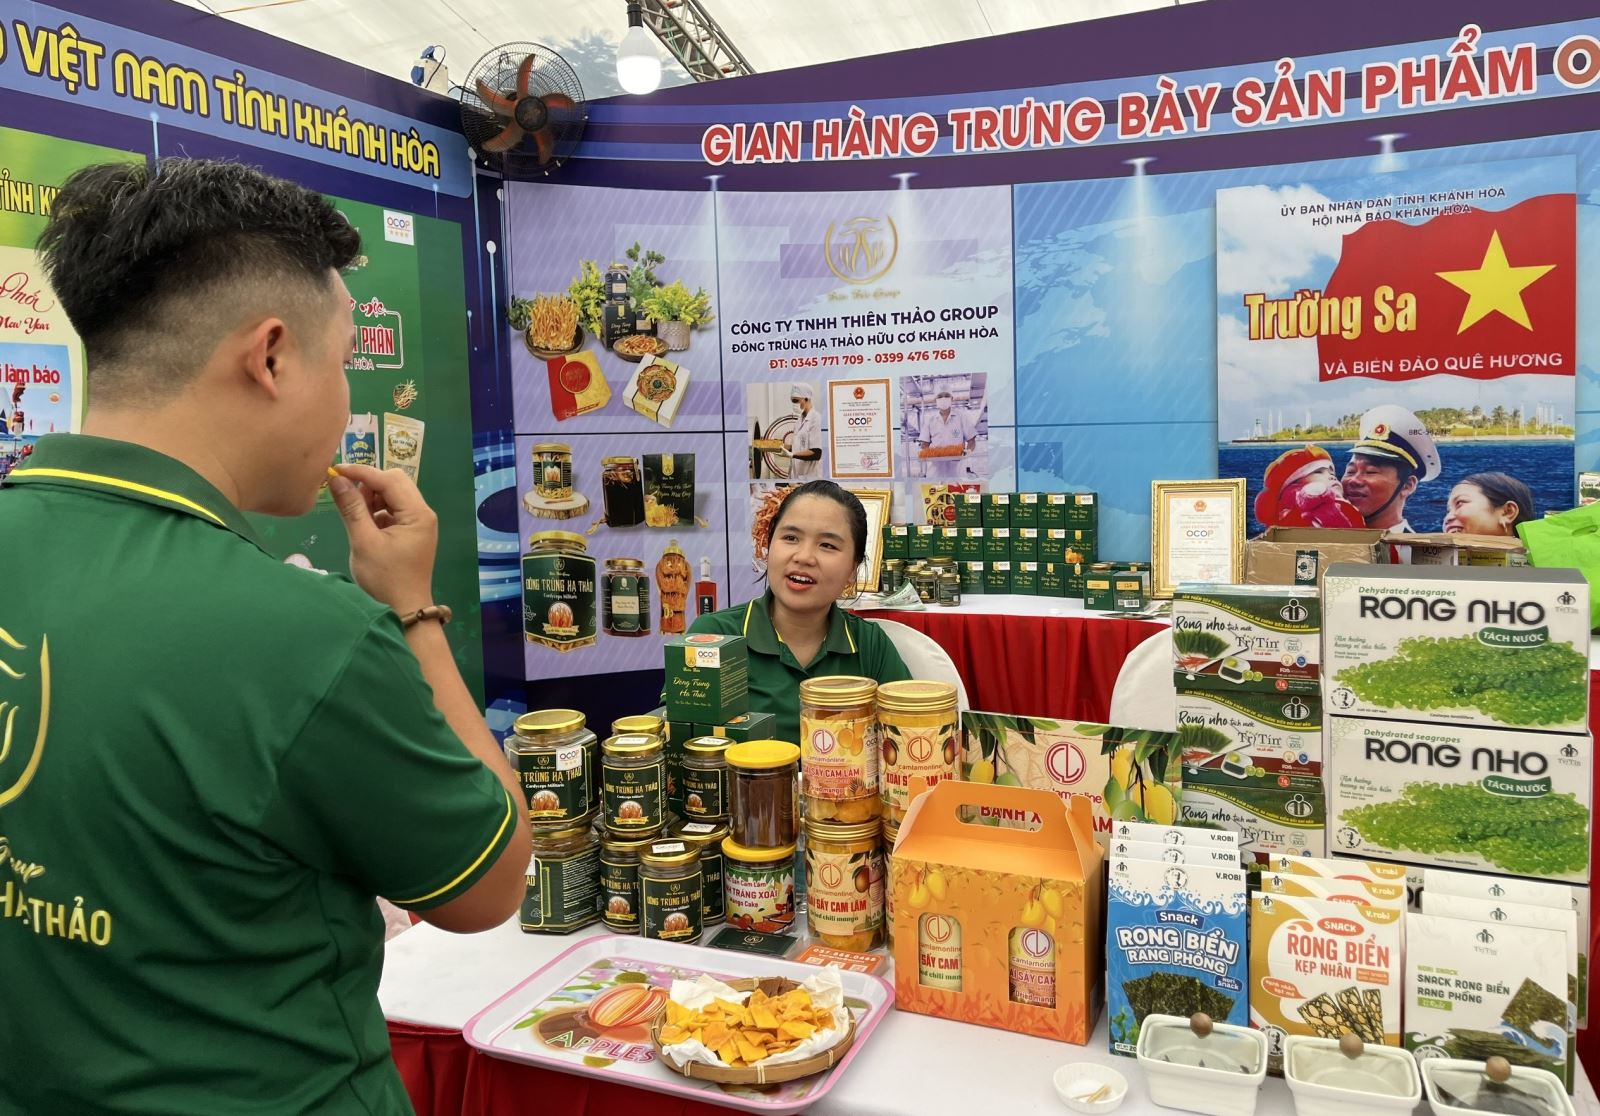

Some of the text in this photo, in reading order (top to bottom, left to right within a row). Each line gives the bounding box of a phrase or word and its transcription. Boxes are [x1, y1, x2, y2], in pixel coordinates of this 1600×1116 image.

[15, 24, 103, 93] VIỆT
[215, 70, 288, 138] TỈNH
[294, 106, 387, 162] KHÁNH
[391, 127, 441, 178] HÒA
[702, 25, 1536, 165] GIAN HÀNG TRƯNG BÀY SẢN PHẨM
[1281, 206, 1296, 217] ỦY
[1300, 203, 1324, 214] BAN
[1329, 200, 1362, 212] NHÂN
[1366, 197, 1392, 208] DÂN
[1429, 188, 1474, 202] KHÁNH
[1478, 186, 1505, 199] HÒA
[387, 216, 410, 228] OCOP
[1312, 203, 1471, 226] HỘI NHÀ BÁO KHÁNH HÒA
[731, 305, 999, 335] CÔNG TY TNHH THIÊN THẢO GROUP
[1244, 285, 1416, 340] Trường Sa
[732, 326, 999, 353] ĐÔNG TRÙNG HẠ THẢO HỮU CƠ KHÁNH HÒA
[769, 359, 788, 369] ĐT:
[790, 357, 818, 368] 0345
[821, 356, 839, 366] 771
[842, 354, 864, 365] 709
[874, 353, 903, 364] 0399
[907, 351, 930, 362] 476
[932, 349, 956, 361] 768
[1324, 350, 1563, 375] VÀ BIỂN ĐẢO QUÊ HƯƠNG
[5, 364, 30, 384] làm
[848, 417, 872, 426] OCOP
[1186, 530, 1214, 538] OCOP
[1358, 586, 1456, 598] Dehydrated seagrapes
[1360, 596, 1545, 625] RONG NHO
[1176, 616, 1202, 632] Rong
[1206, 617, 1225, 631] nho
[1483, 630, 1545, 643] TÁCH NƯỚC
[1179, 711, 1204, 728] Rong
[1209, 712, 1228, 727] nho
[1364, 728, 1461, 744] Dehydrated seagrapes
[1365, 738, 1548, 775] RONG NHO
[1487, 778, 1548, 793] TÁCH NƯỚC
[1182, 806, 1207, 823] Rong
[1212, 807, 1231, 821] nho
[1210, 834, 1234, 842] V.ROBI
[1211, 852, 1236, 861] V.ROBI
[1216, 872, 1242, 881] V.ROBI
[1375, 867, 1398, 876] V.robi
[733, 887, 757, 899] TRÁNG
[1372, 886, 1396, 896] V.robi
[831, 901, 848, 912] CAM
[1366, 909, 1391, 920] V.robi
[28, 895, 112, 946] THẢO
[1160, 912, 1199, 926] Snack
[1324, 920, 1357, 933] SNACK
[1119, 928, 1237, 961] RONG BIỂN
[1288, 933, 1390, 969] RONG BIỂN
[1128, 949, 1170, 962] RANG
[938, 958, 959, 970] CAM
[1295, 959, 1317, 976] KẸP
[1320, 964, 1352, 980] NHÂN
[929, 972, 944, 980] chili
[1455, 980, 1483, 992] RONG
[1486, 981, 1510, 995] BIỂN
[545, 1030, 657, 1064] APPLES
